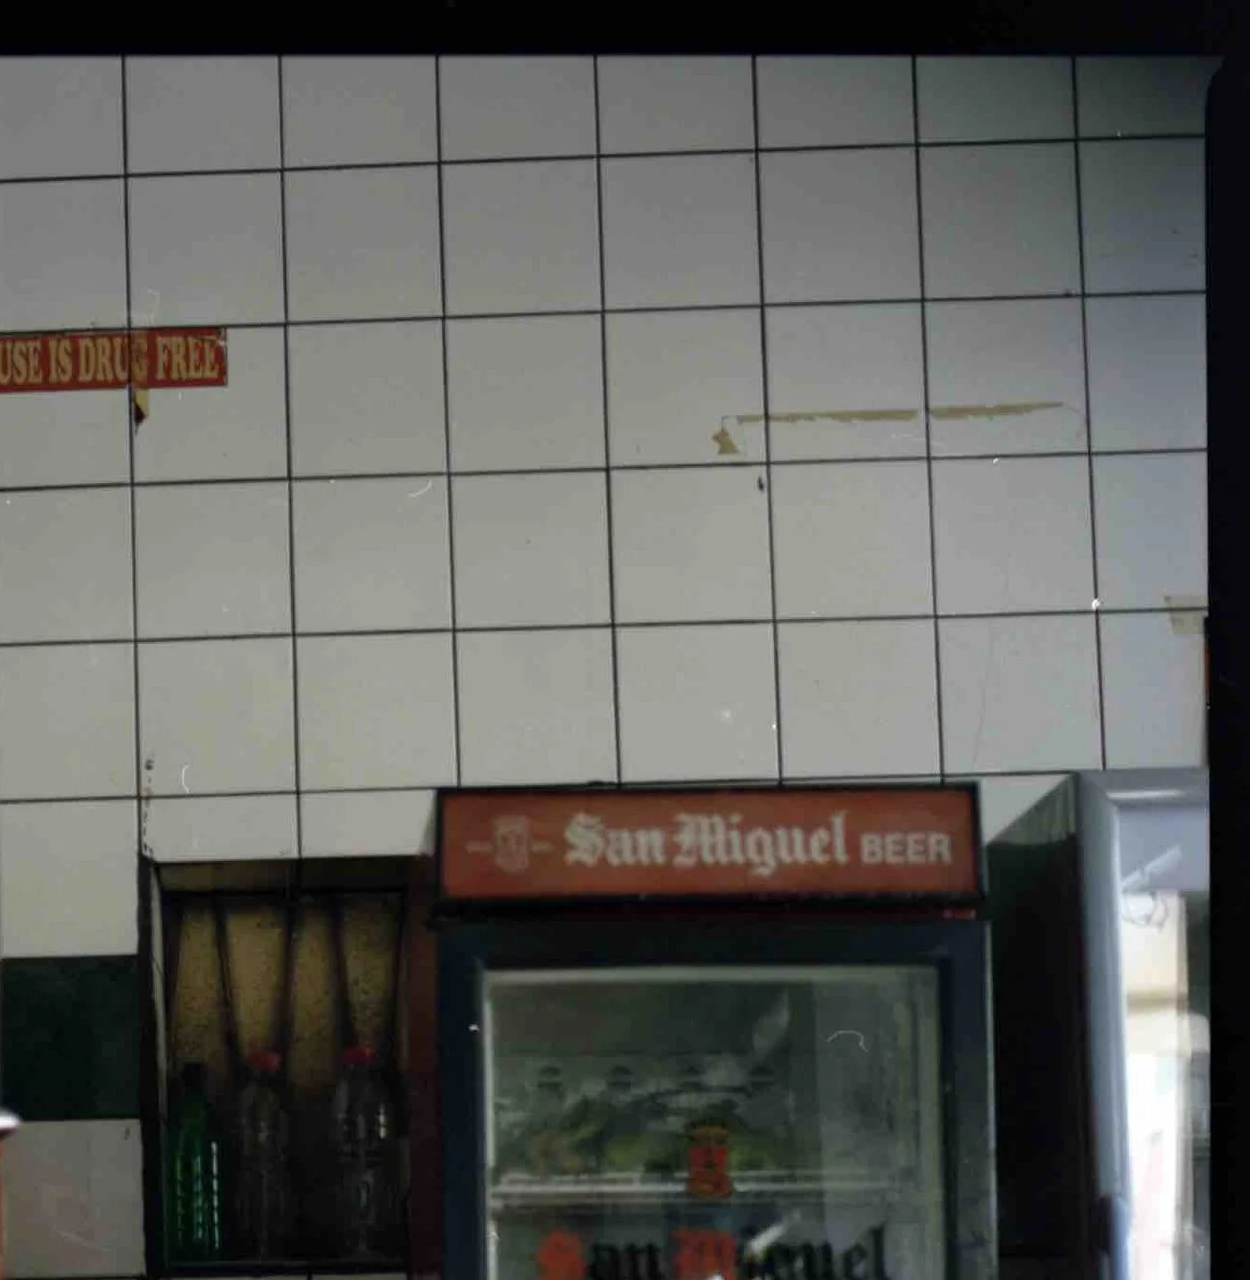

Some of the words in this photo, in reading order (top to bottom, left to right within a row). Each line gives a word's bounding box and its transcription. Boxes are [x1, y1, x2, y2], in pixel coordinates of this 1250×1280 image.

[49, 335, 73, 383] IS
[78, 331, 148, 382] DRUG
[155, 332, 221, 381] FREE
[564, 812, 664, 866] San
[673, 810, 849, 876] Miguel
[860, 832, 952, 864] BEER
